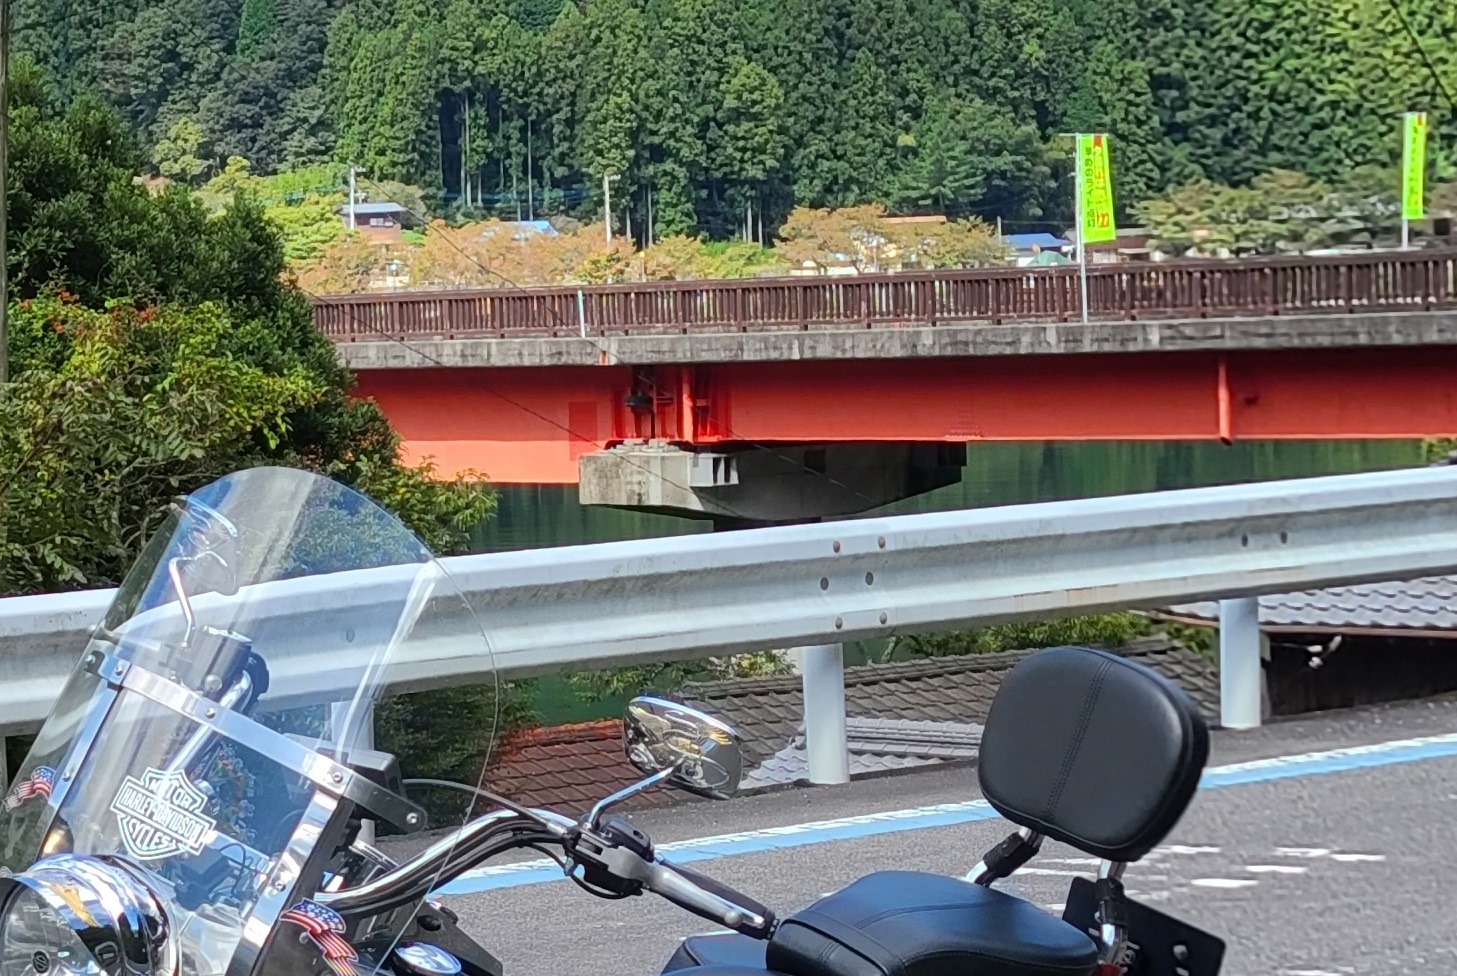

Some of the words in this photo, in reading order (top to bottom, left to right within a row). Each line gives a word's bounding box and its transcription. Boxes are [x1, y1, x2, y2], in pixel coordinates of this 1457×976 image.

[149, 778, 193, 810] MTOR
[119, 787, 205, 847] HARLEY-DAVIDSON
[129, 818, 170, 851] CYCLES
